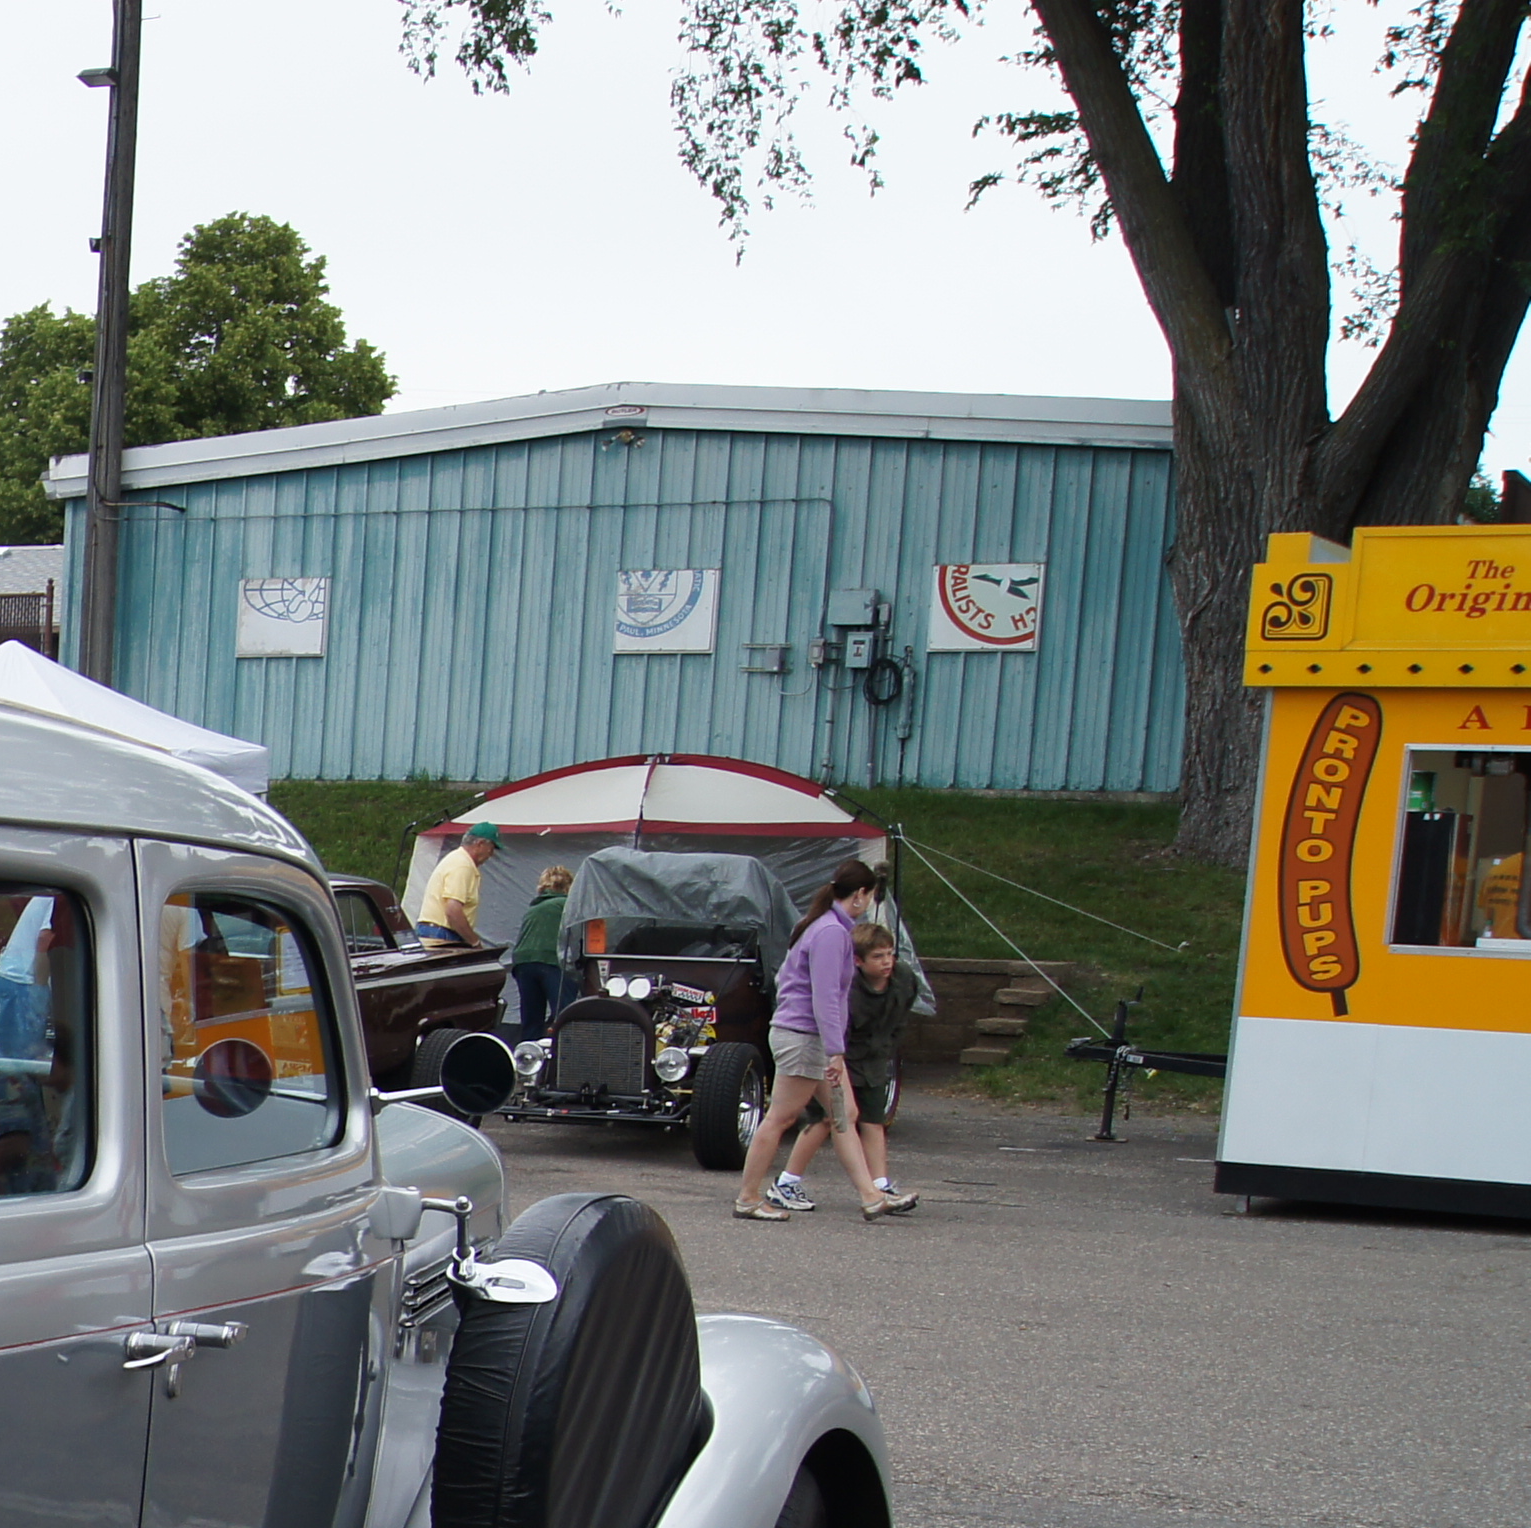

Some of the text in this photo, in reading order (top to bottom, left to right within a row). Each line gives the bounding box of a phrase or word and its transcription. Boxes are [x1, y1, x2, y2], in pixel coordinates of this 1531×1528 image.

[1466, 560, 1516, 579] The
[1405, 583, 1531, 619] Origin
[645, 604, 693, 637] MINNESOTA
[1457, 705, 1493, 730] A
[1295, 705, 1371, 981] PRONTO PUPS
